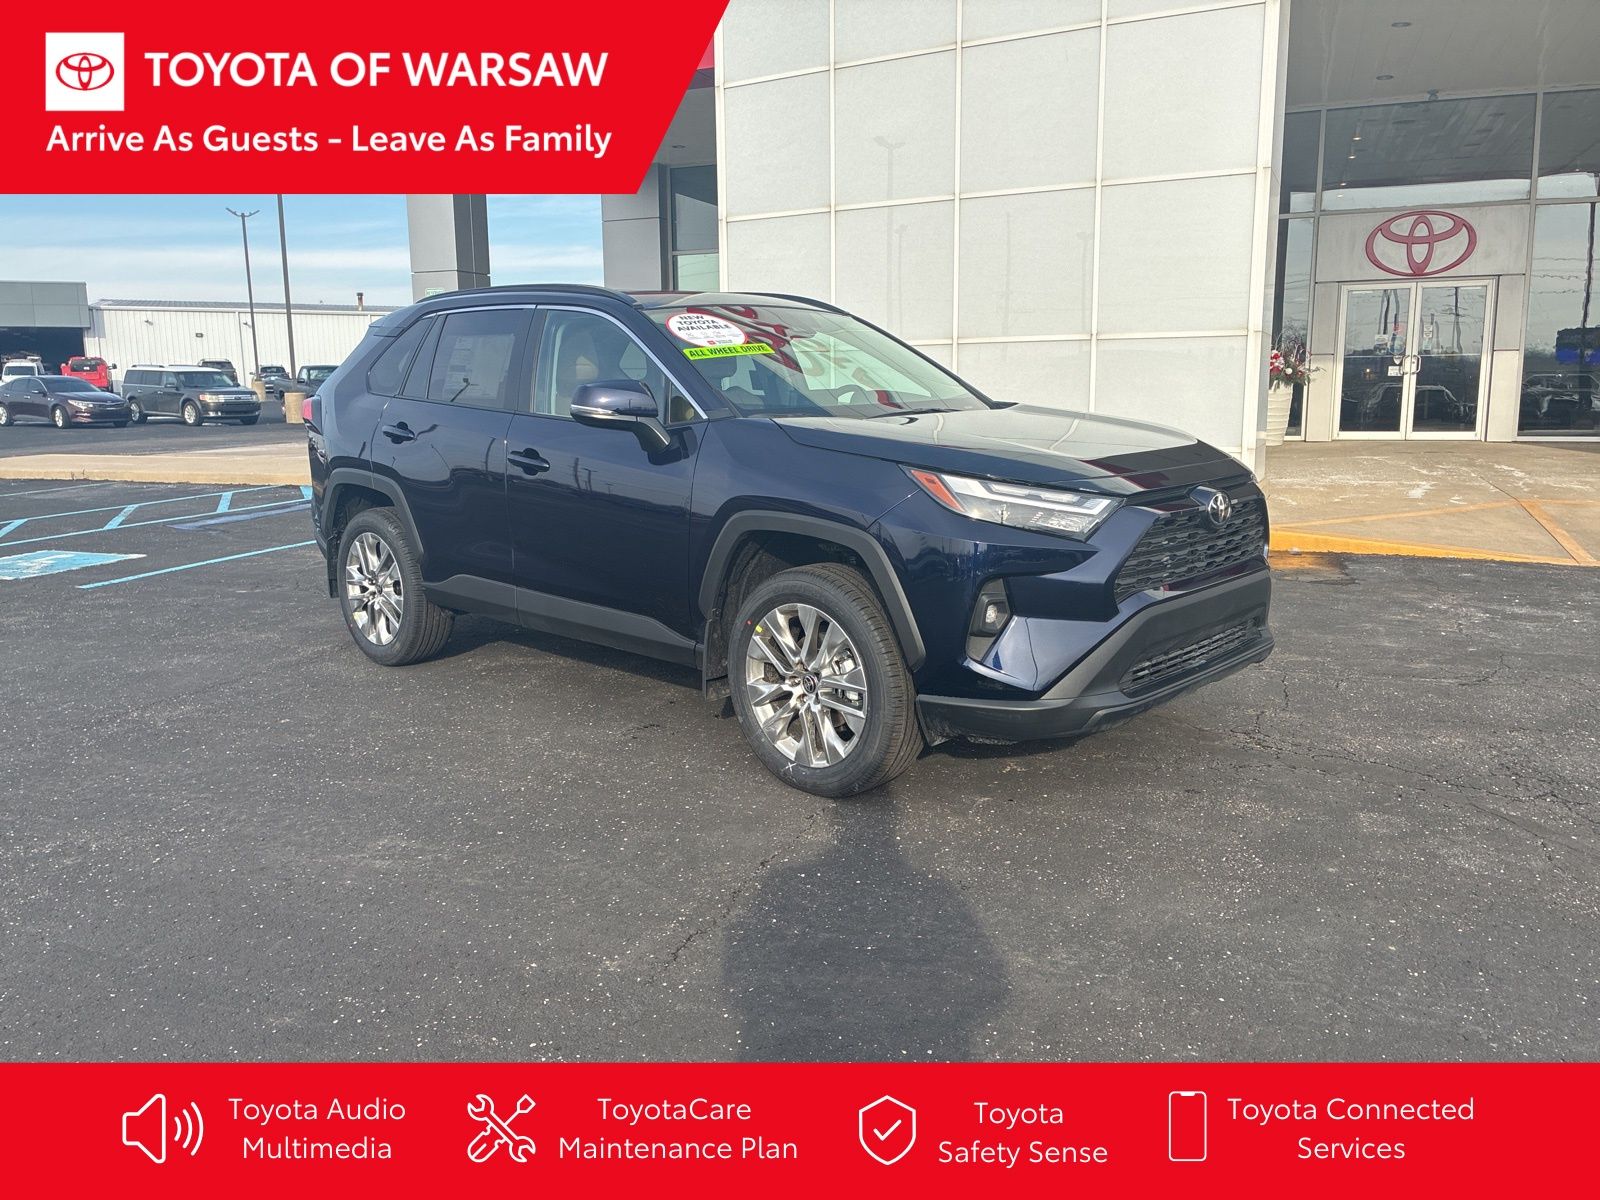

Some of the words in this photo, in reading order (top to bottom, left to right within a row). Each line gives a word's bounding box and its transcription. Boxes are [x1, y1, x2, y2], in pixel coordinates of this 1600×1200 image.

[677, 324, 731, 332] AVAILABLE
[689, 349, 706, 357] ALL
[708, 346, 740, 356] WHEEL
[741, 344, 768, 353] DRIVE
